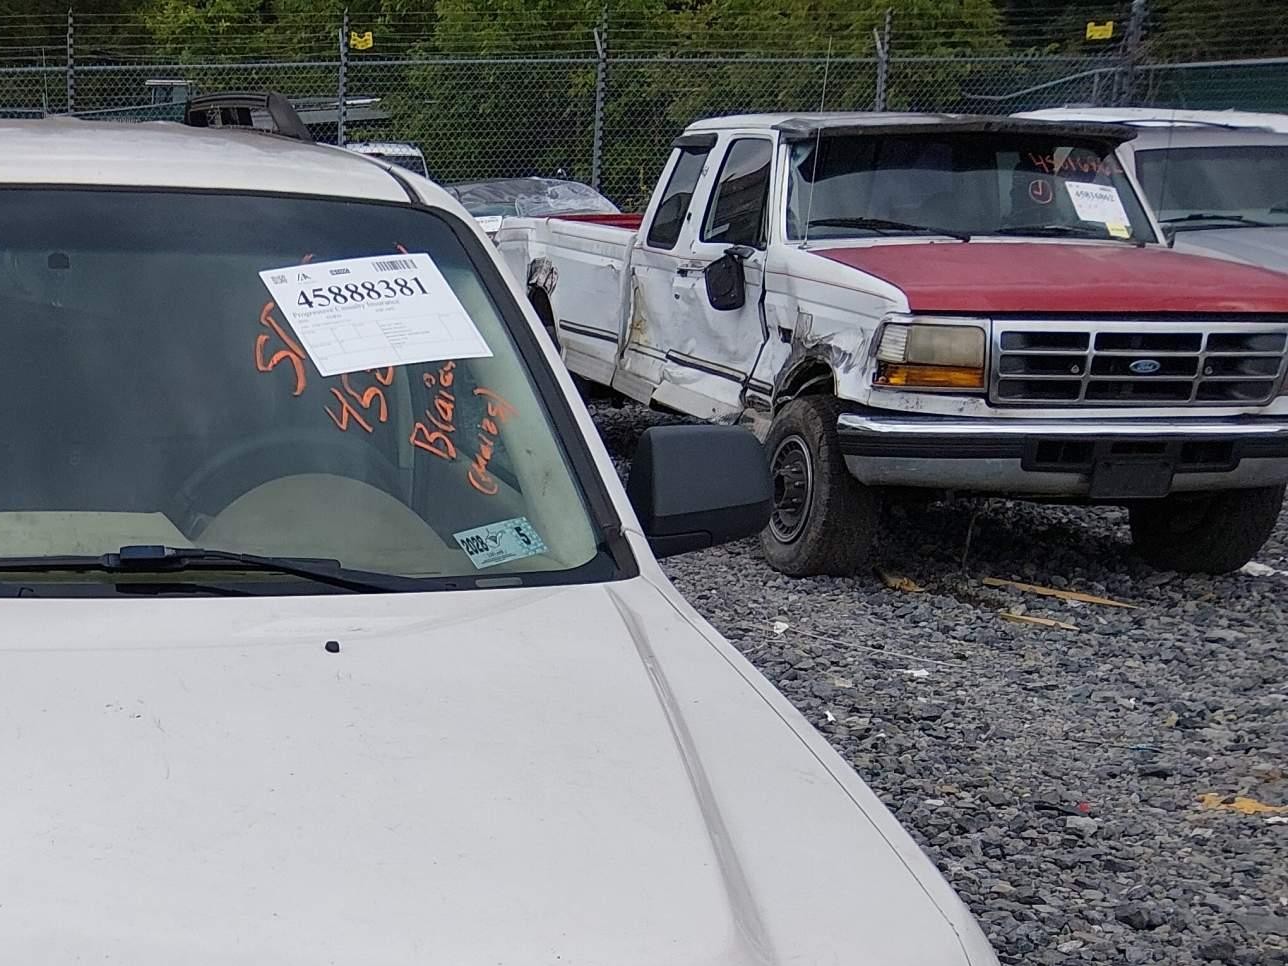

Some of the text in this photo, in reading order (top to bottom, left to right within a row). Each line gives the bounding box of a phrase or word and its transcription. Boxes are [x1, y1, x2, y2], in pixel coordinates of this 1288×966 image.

[297, 276, 429, 309] 45888381
[460, 534, 489, 556] 2028
[514, 526, 532, 546] 5
